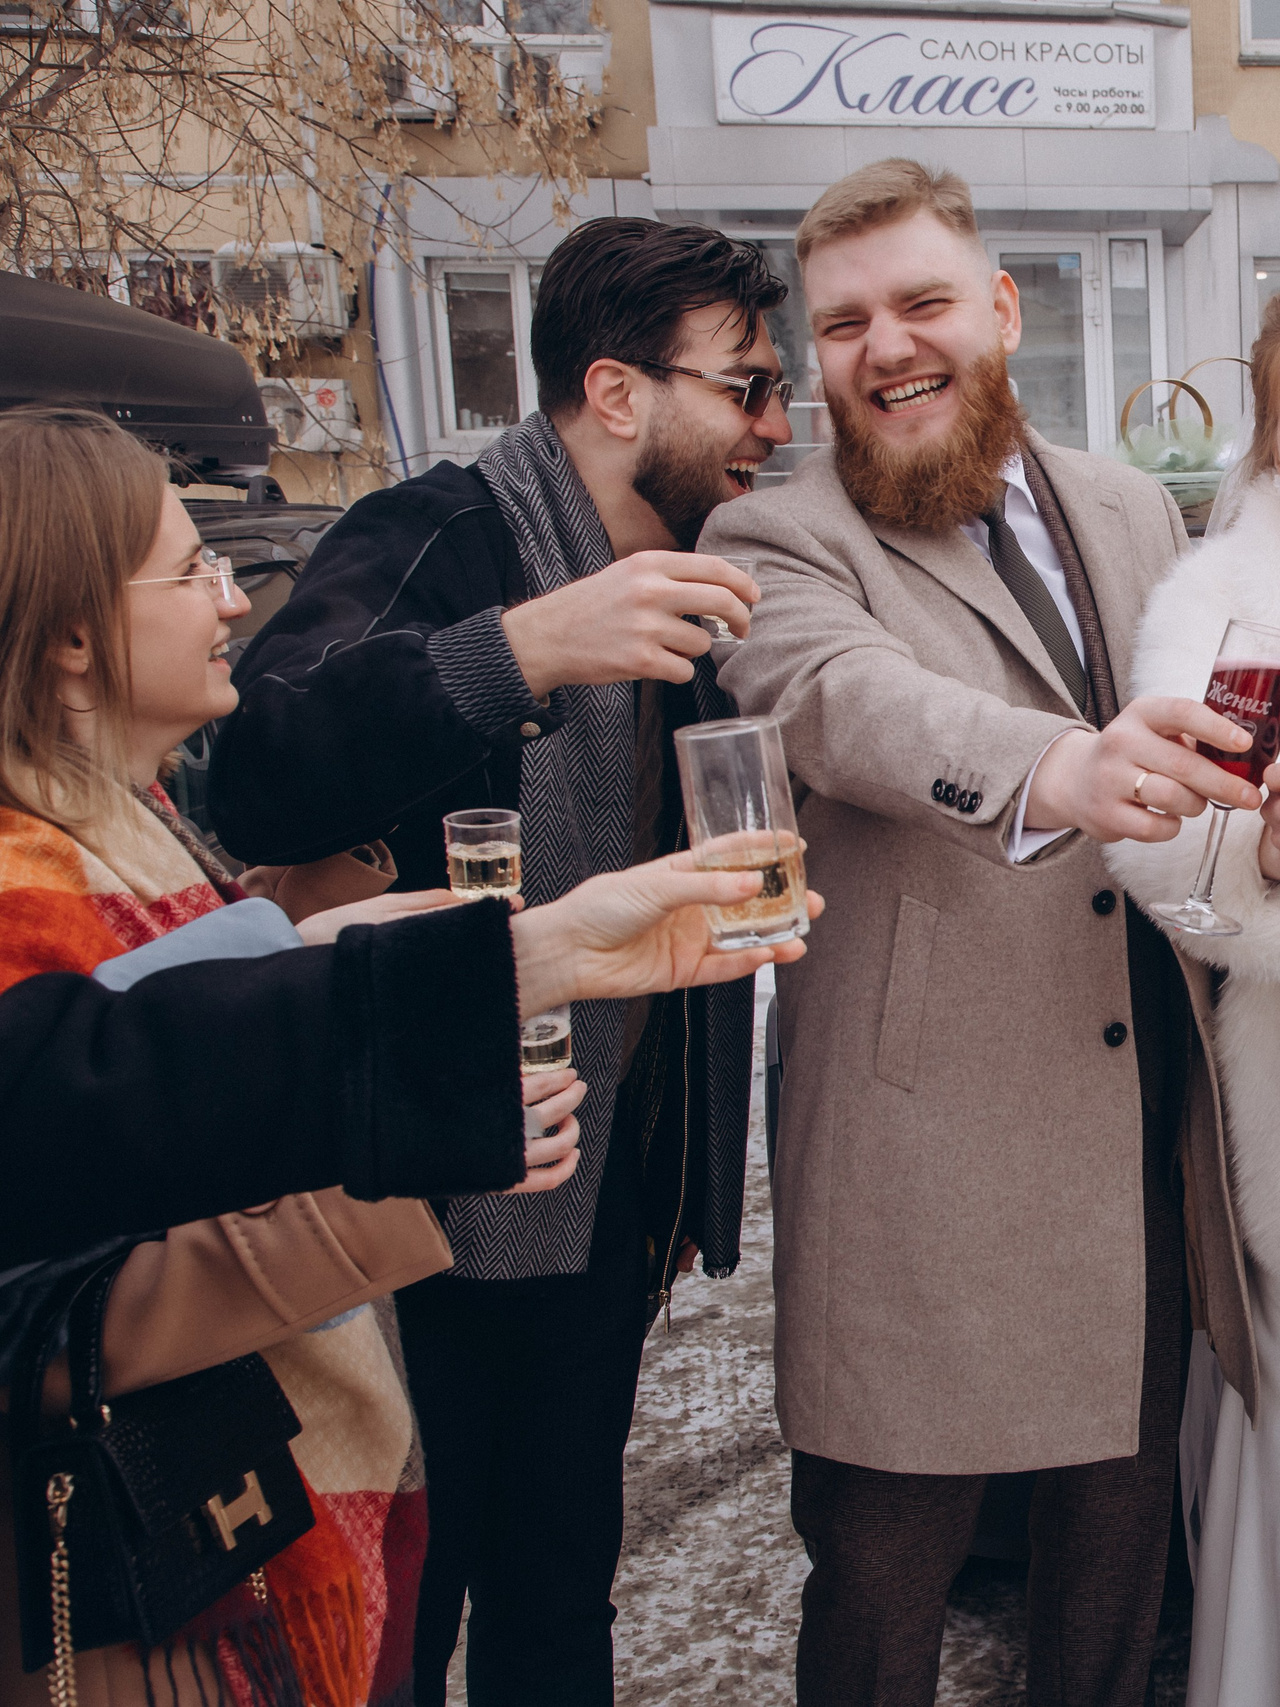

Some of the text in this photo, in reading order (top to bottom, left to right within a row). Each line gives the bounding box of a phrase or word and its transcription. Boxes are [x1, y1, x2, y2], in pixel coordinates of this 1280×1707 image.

[920, 38, 1144, 64] САЛОН КРАСОТЫ
[730, 22, 1038, 117] Класс
[1053, 86, 1144, 99] Часы работы:
[1054, 102, 1145, 114] с 9.00 до 20.00
[1207, 679, 1273, 715] Жених
